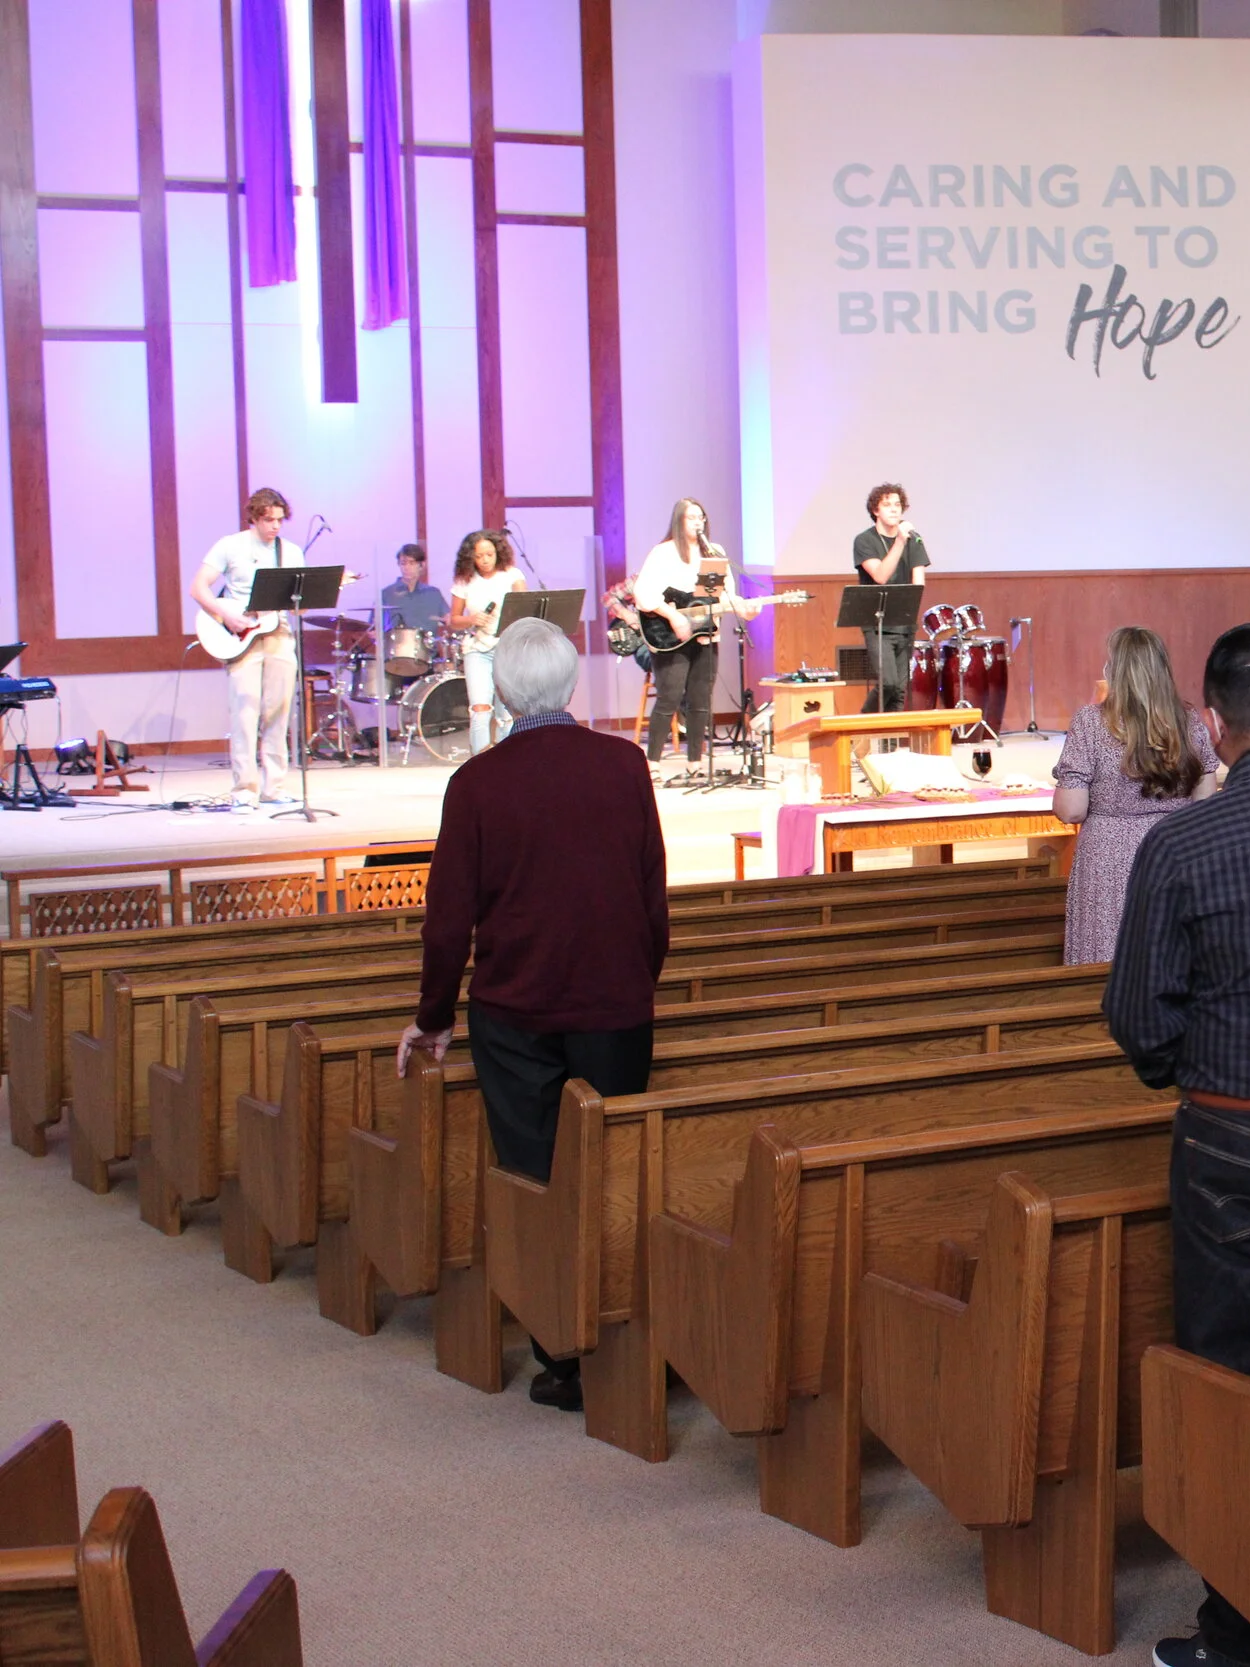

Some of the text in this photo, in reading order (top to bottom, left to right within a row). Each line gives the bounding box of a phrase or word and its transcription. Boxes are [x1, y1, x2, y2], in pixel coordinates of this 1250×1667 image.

[832, 163, 1236, 208] CARING AND
[835, 225, 1218, 270] SERVING TO
[837, 263, 1240, 381] BRING Hope
